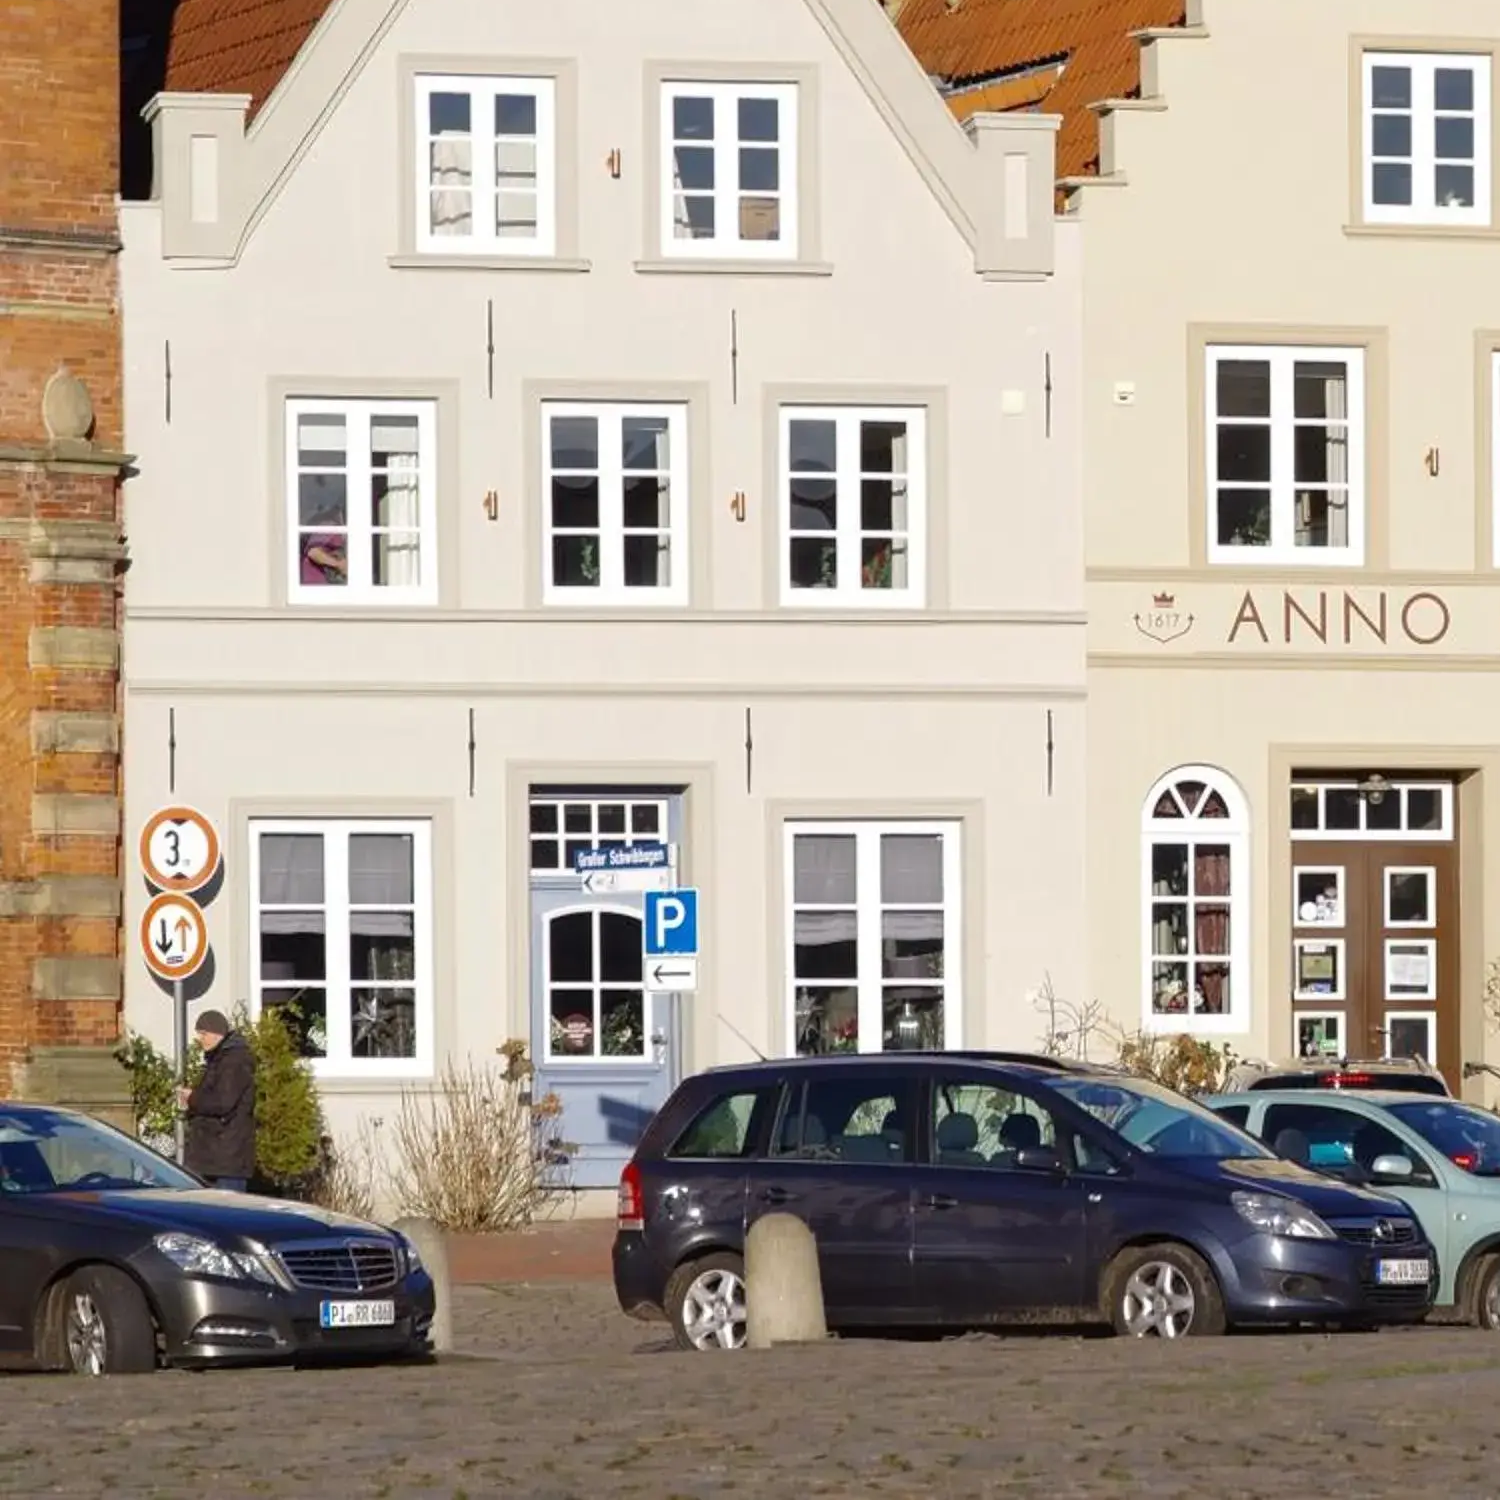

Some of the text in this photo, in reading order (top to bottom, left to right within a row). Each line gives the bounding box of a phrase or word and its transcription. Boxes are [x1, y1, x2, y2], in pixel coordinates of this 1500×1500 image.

[1147, 612, 1180, 629] 1617
[1227, 590, 1450, 645] ANNO
[164, 830, 180, 867] 3
[656, 897, 686, 949] P
